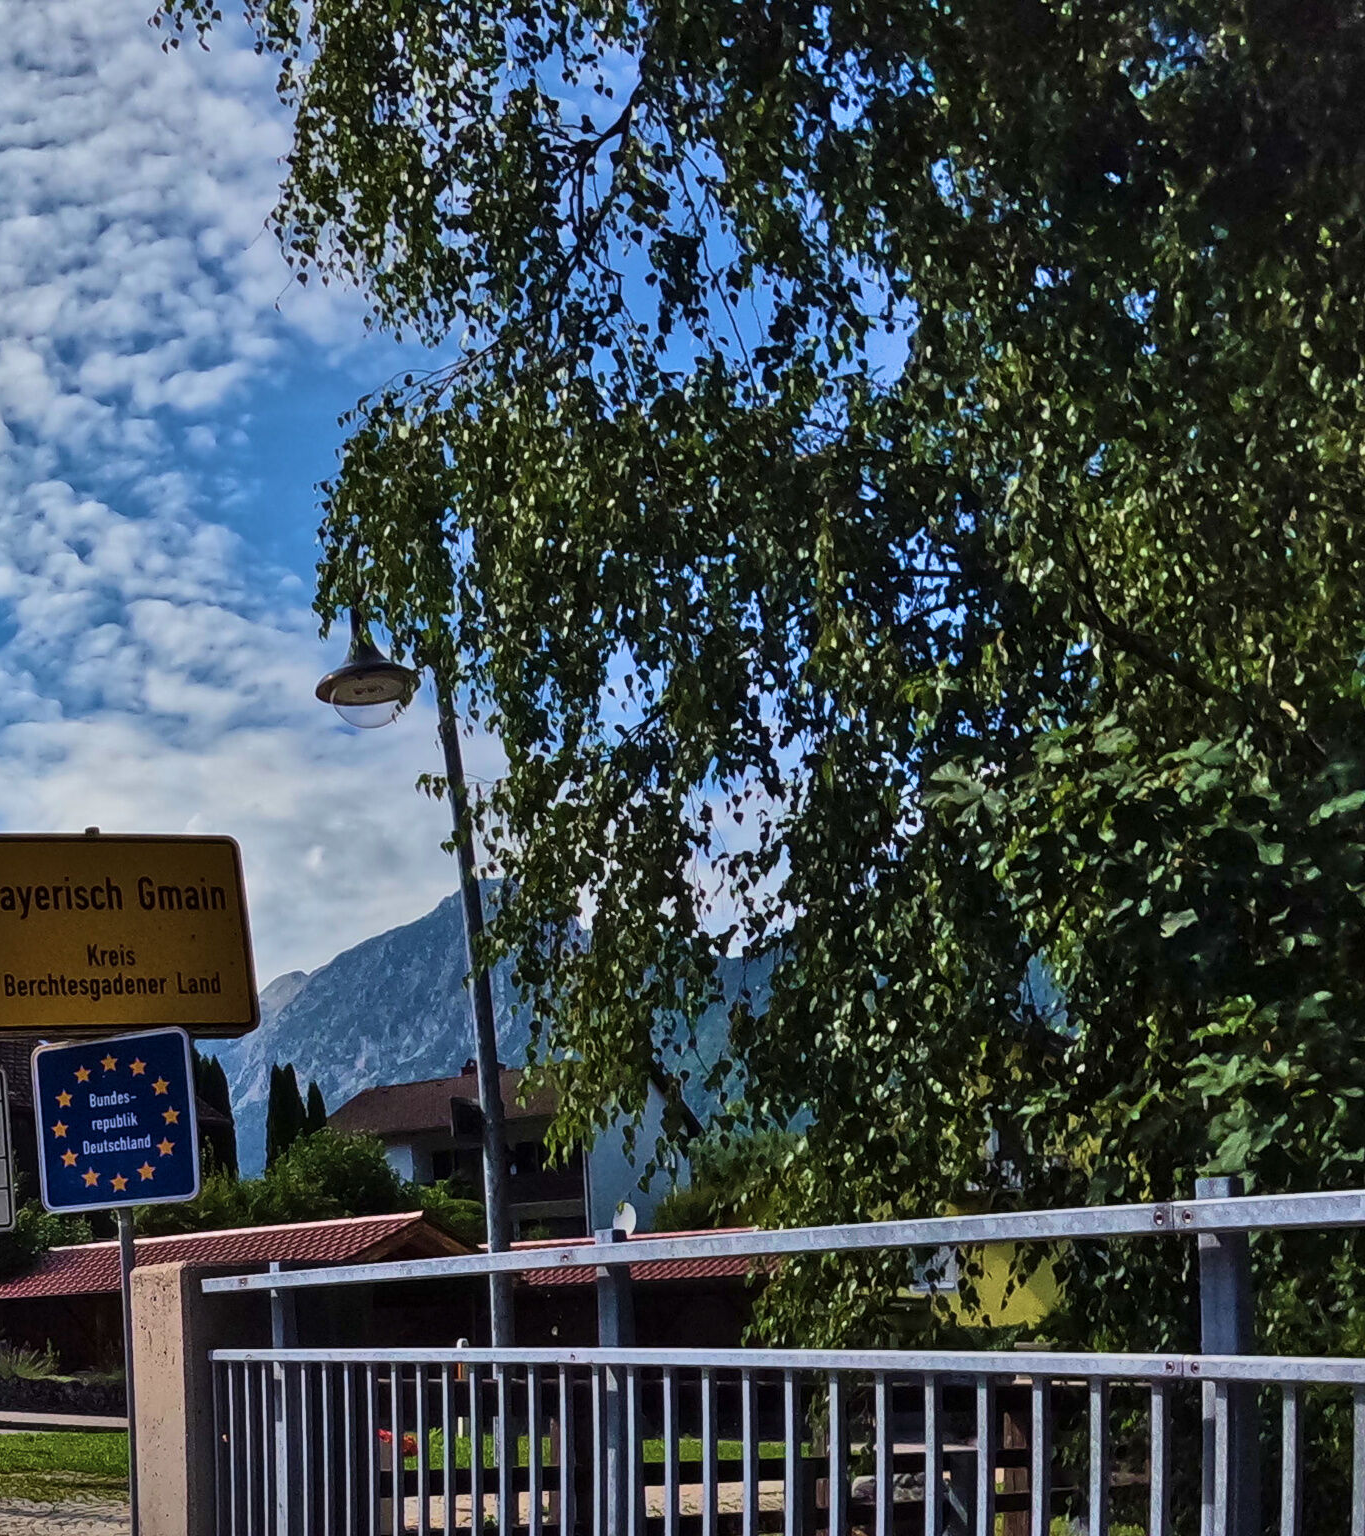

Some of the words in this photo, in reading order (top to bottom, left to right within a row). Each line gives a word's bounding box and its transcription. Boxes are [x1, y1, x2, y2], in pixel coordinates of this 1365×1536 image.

[137, 876, 227, 910] Gmain
[86, 944, 136, 967] Kreis
[3, 973, 168, 1001] Berchtesgadener
[177, 972, 222, 995] Land
[89, 1090, 138, 1108] Bundes-
[91, 1112, 139, 1133] republik
[82, 1133, 152, 1155] Deutschland
